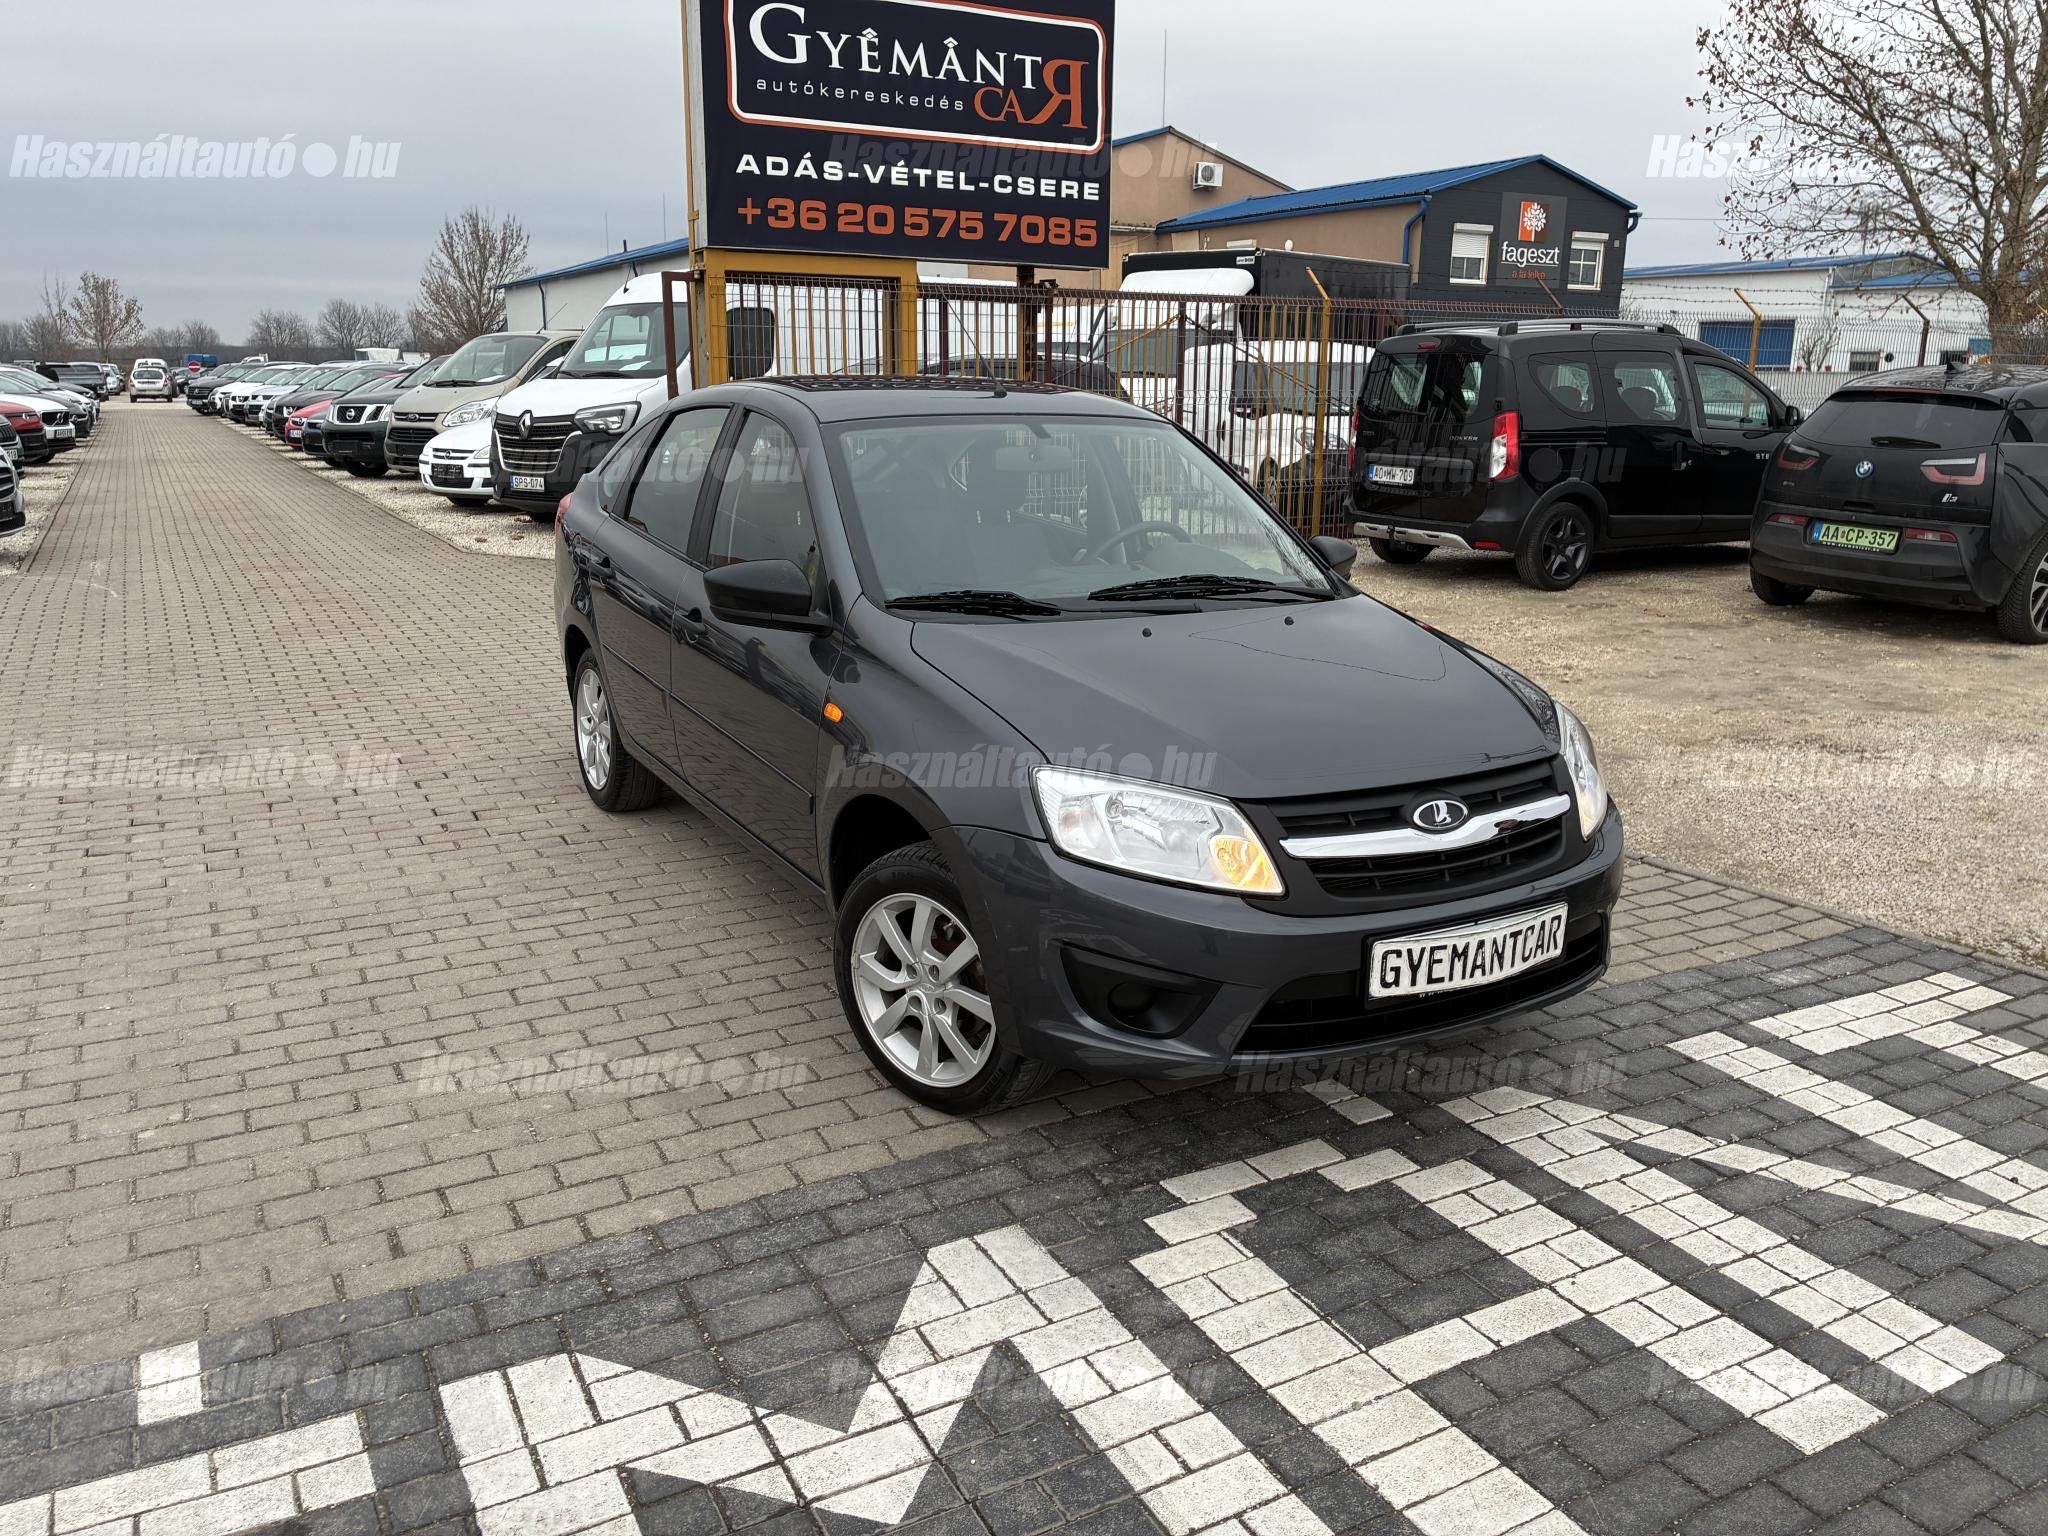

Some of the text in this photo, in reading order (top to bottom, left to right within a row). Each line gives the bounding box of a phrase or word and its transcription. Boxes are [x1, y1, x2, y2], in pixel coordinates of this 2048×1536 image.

[755, 76, 965, 111] autókereskedés
[735, 151, 1101, 201] ADÁS-VÉTEL-CSERE
[737, 196, 1098, 248] +36 20 575 7085
[1501, 240, 1560, 267] fageszt
[1379, 913, 1562, 989] GYEMANTCAR
